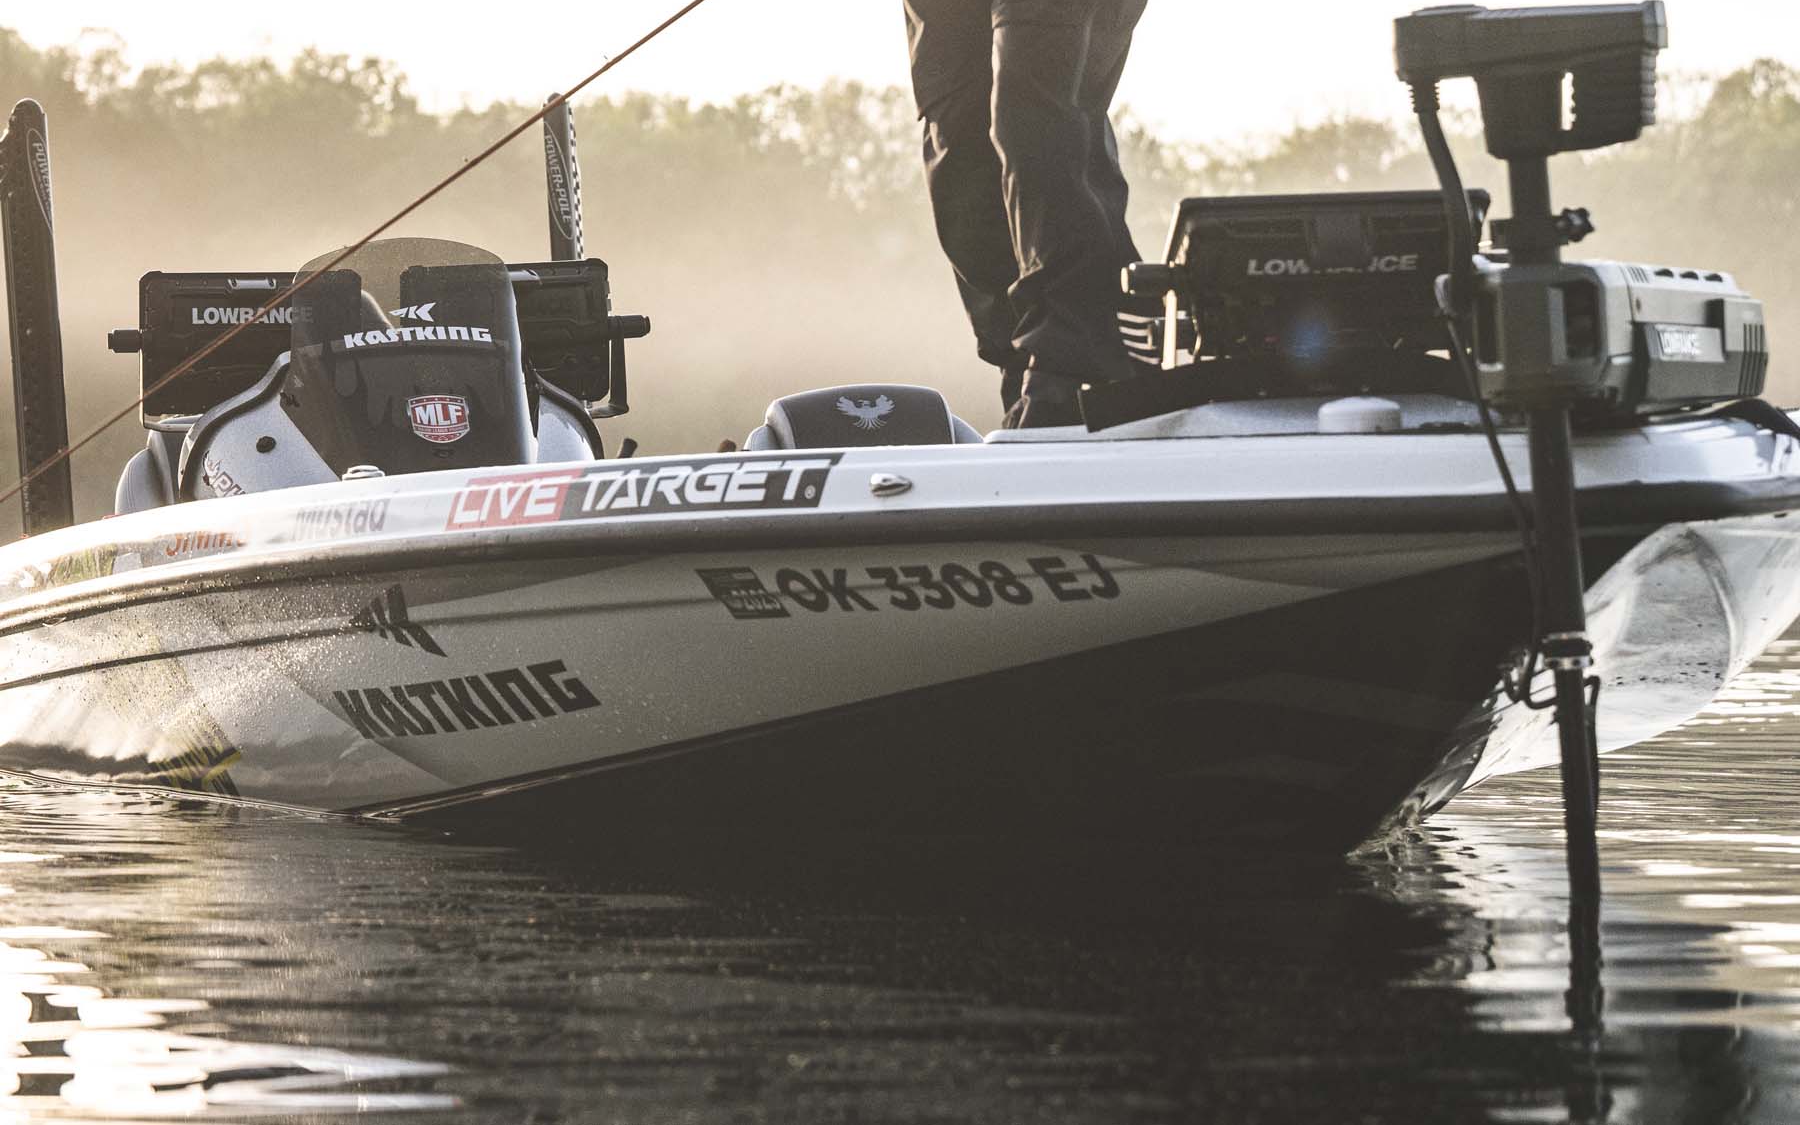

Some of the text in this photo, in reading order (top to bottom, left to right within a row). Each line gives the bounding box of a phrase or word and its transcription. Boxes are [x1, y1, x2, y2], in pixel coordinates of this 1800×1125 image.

[414, 403, 462, 426] MLF
[453, 474, 572, 524] LIVE
[776, 554, 1121, 613] OK 3308 EJ
